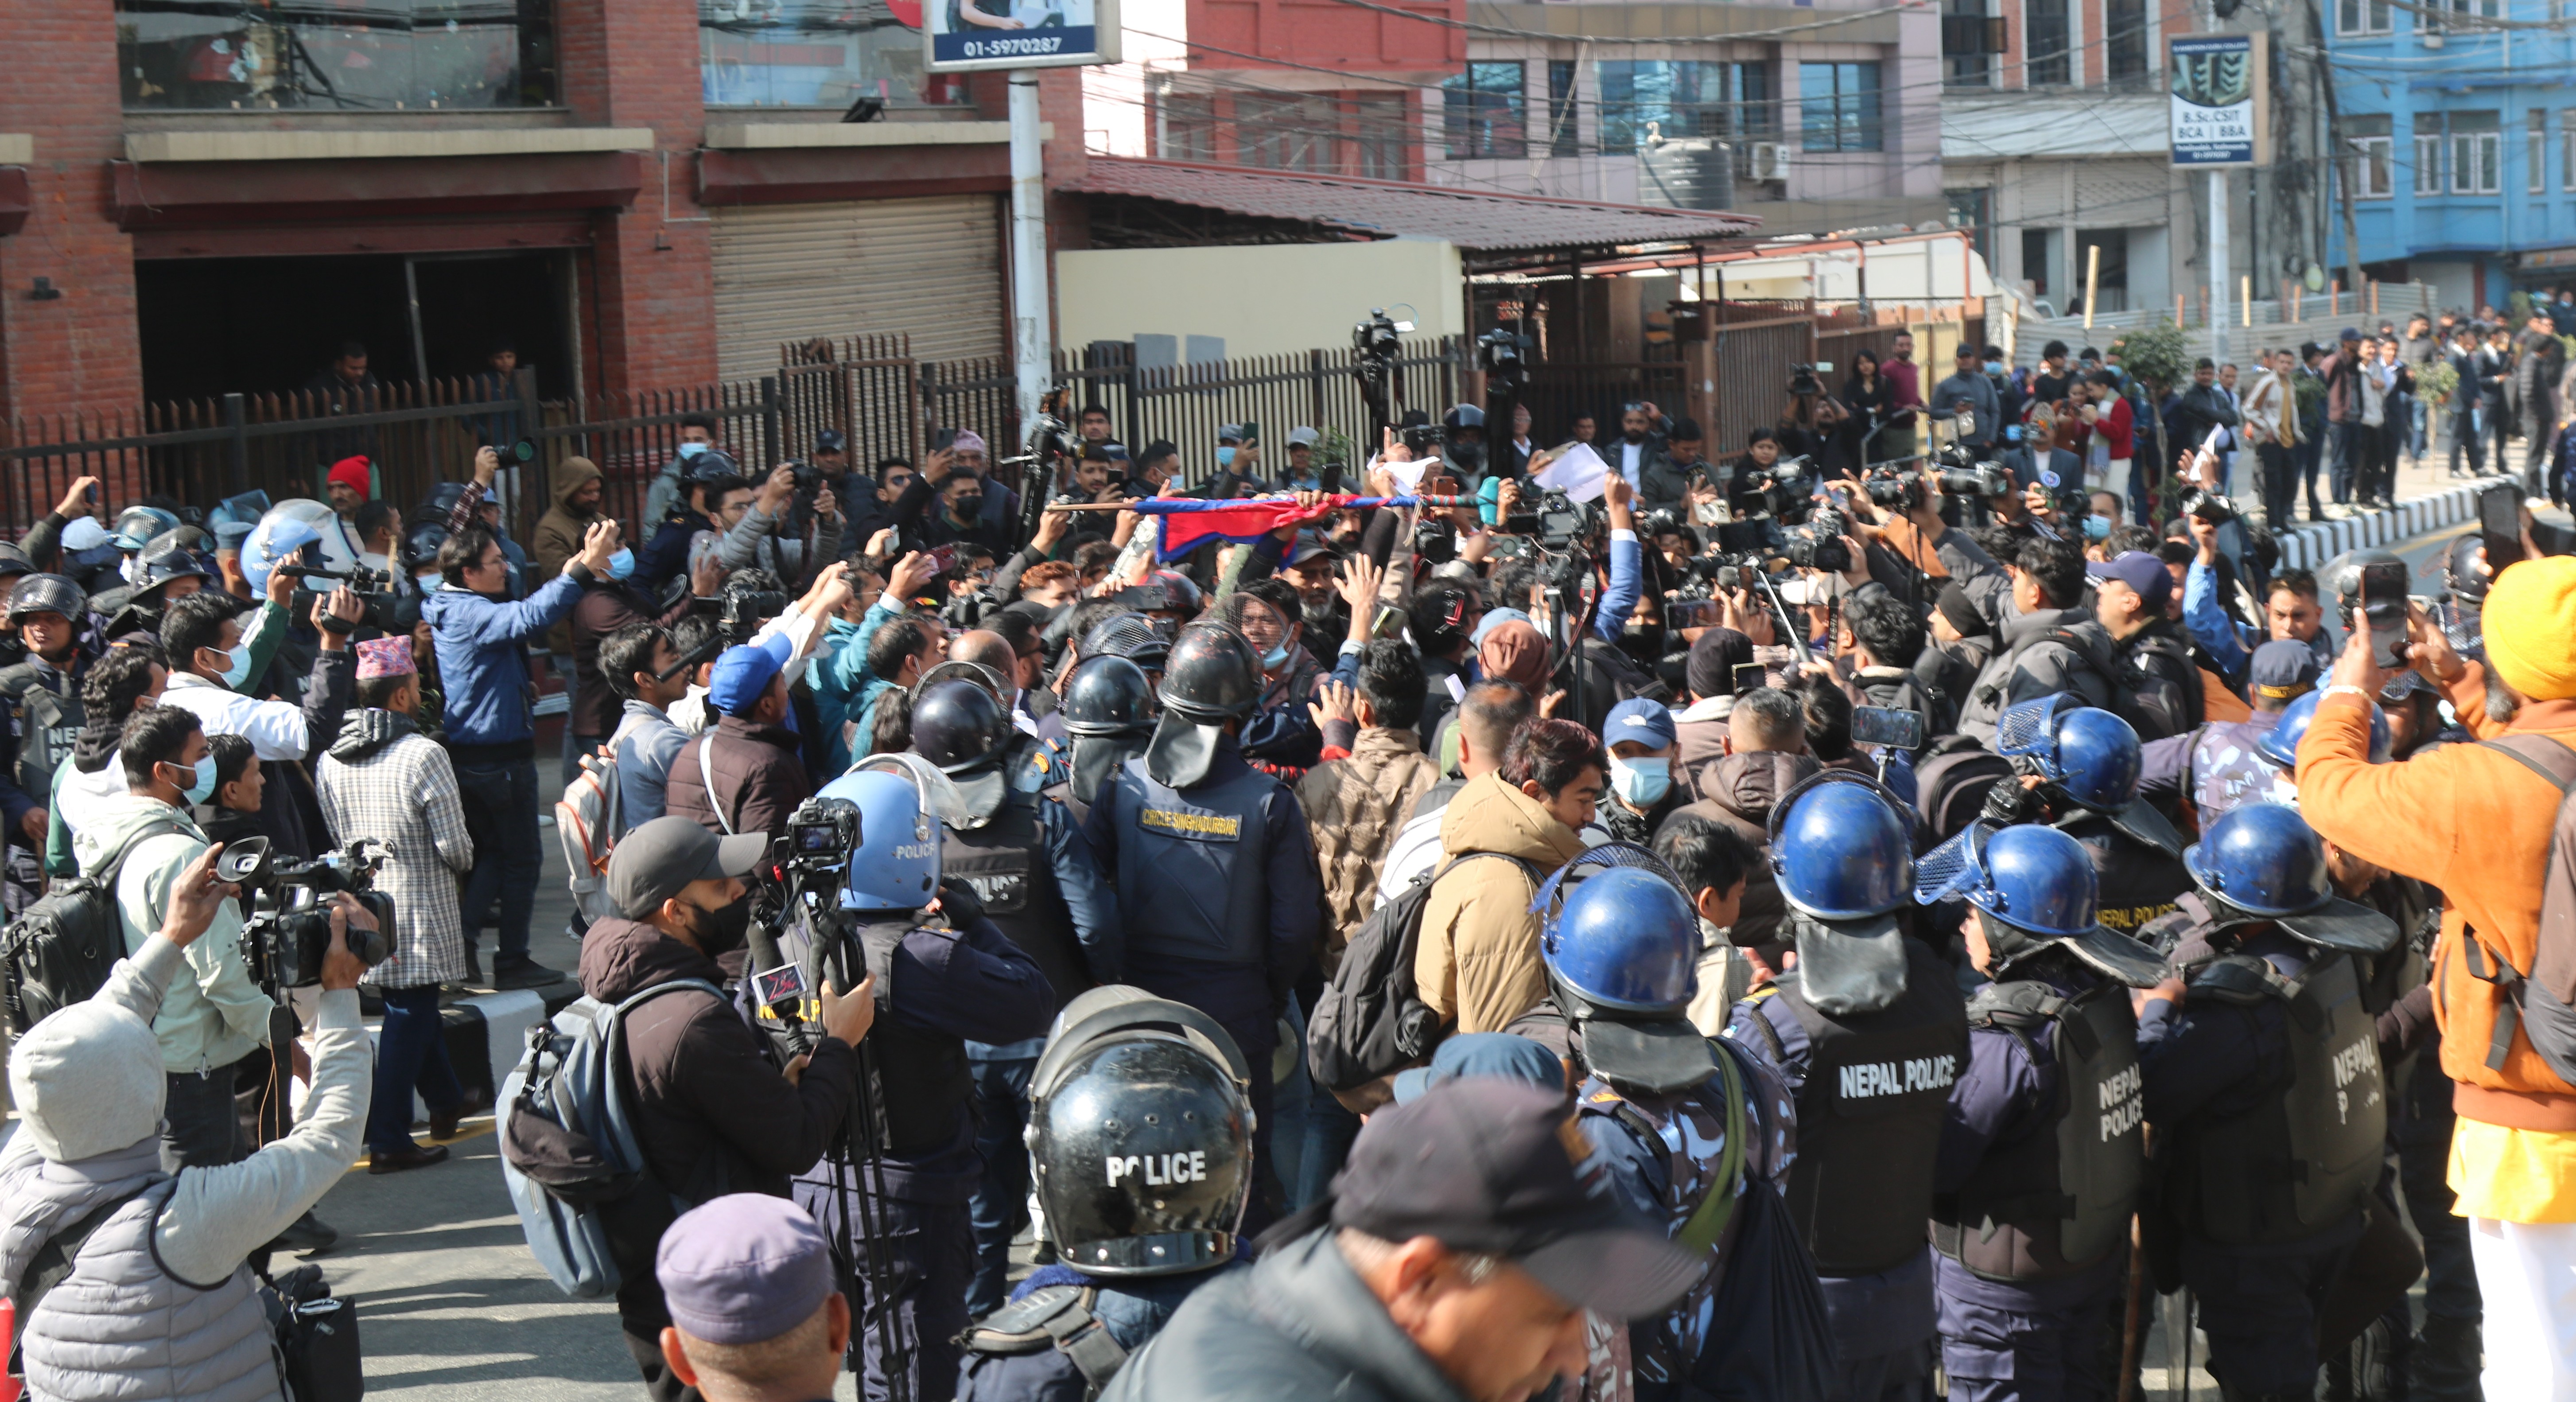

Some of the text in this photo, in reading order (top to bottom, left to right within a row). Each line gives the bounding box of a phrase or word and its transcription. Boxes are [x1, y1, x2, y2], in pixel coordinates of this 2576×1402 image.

[964, 37, 1062, 56] 01-5970287
[2178, 125, 2246, 138] BCA BBA
[1142, 809, 1237, 837] CIRCLE SINGHADURBAR
[1840, 1055, 1956, 1099] NEPAL POLICE
[2332, 1034, 2376, 1089] NEPAL
[2098, 1062, 2142, 1110] NEPAL
[2100, 1092, 2143, 1142] POLICE
